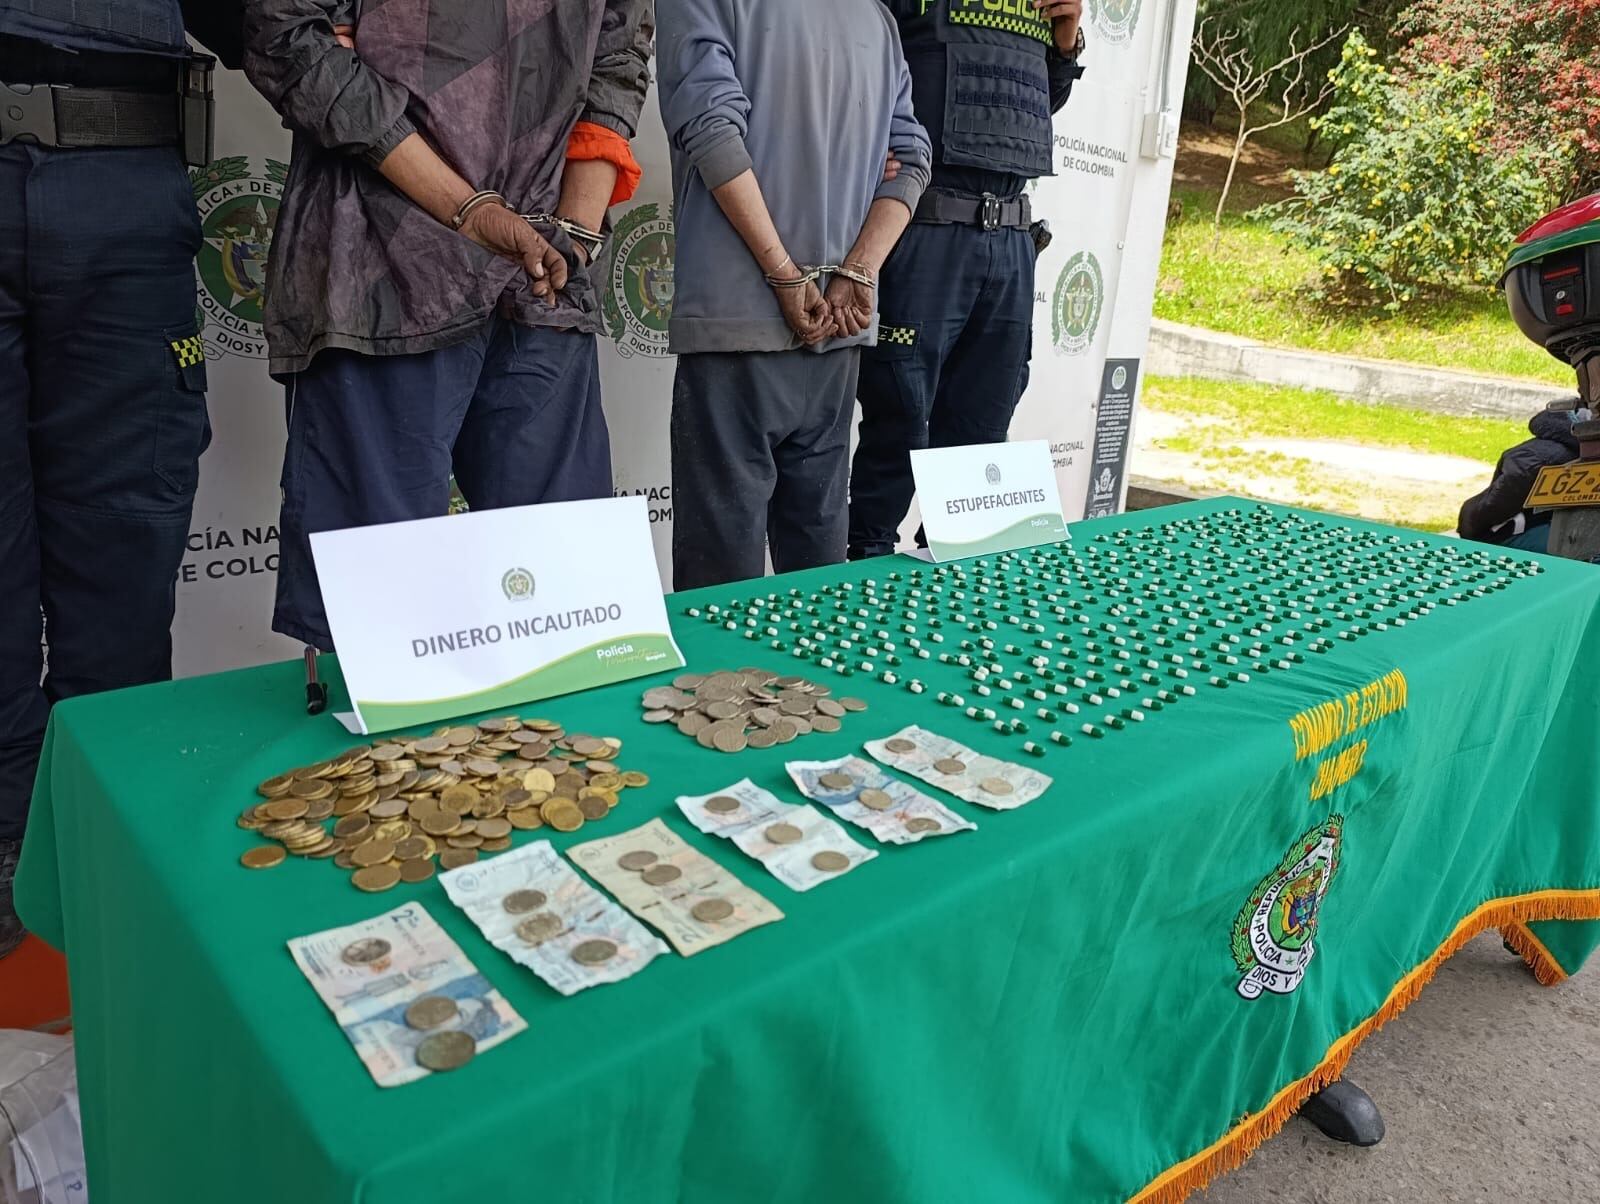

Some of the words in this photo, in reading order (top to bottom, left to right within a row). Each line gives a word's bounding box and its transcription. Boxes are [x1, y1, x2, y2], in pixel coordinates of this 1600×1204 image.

[1087, 144, 1128, 163] NACIONAL
[1063, 156, 1075, 169] DE
[1075, 159, 1114, 178] COLOMBIA
[250, 181, 272, 194] DE
[658, 222, 672, 231] DE
[216, 331, 253, 353] DIOS
[945, 489, 1046, 515] ESTUPEFACIENTES
[411, 624, 502, 658] DINERO
[507, 603, 622, 640] INCAUTADO
[1345, 691, 1360, 736] DE
[1253, 923, 1282, 964] POLICIA
[1251, 966, 1278, 987] DIOS
[1284, 976, 1292, 989] Y
